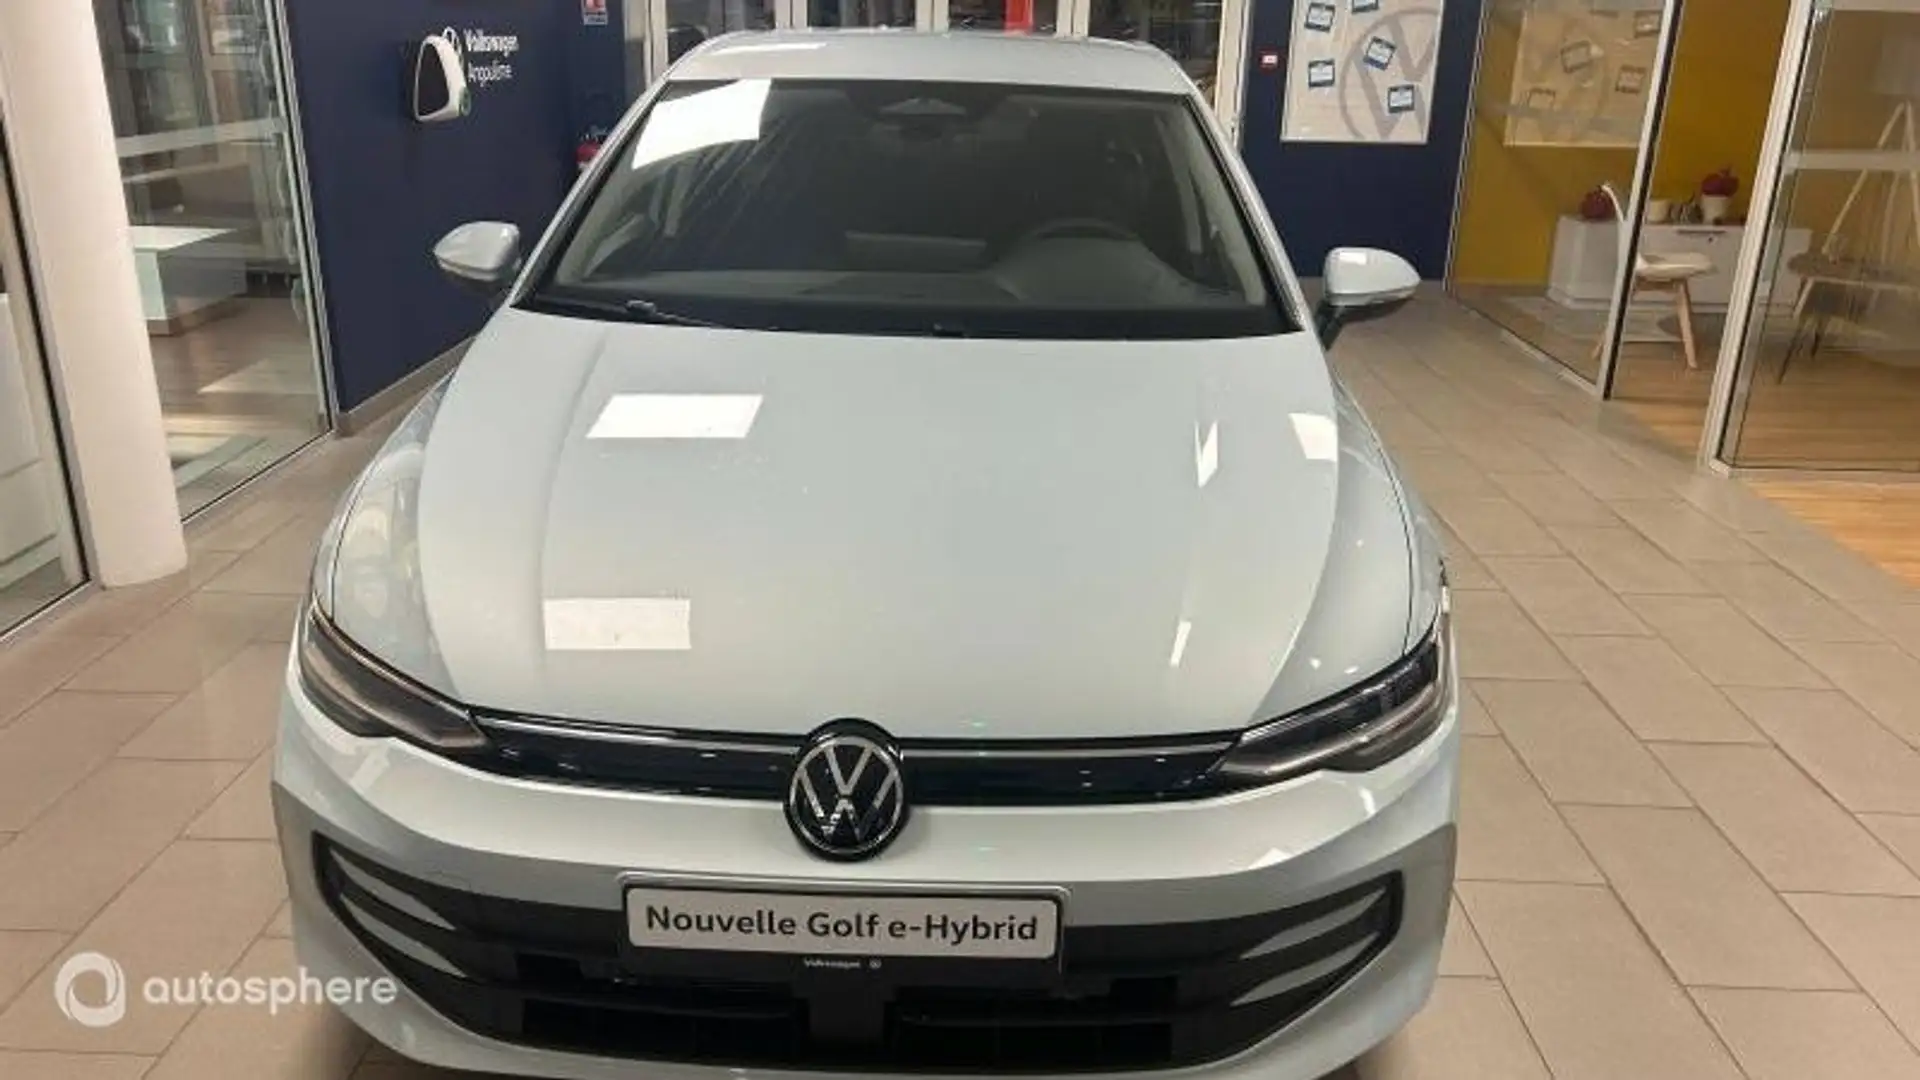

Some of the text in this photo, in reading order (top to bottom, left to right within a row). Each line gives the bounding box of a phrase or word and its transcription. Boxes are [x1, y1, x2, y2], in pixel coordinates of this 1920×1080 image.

[646, 905, 1038, 946] Nouvelle Golf e-Hybrid
